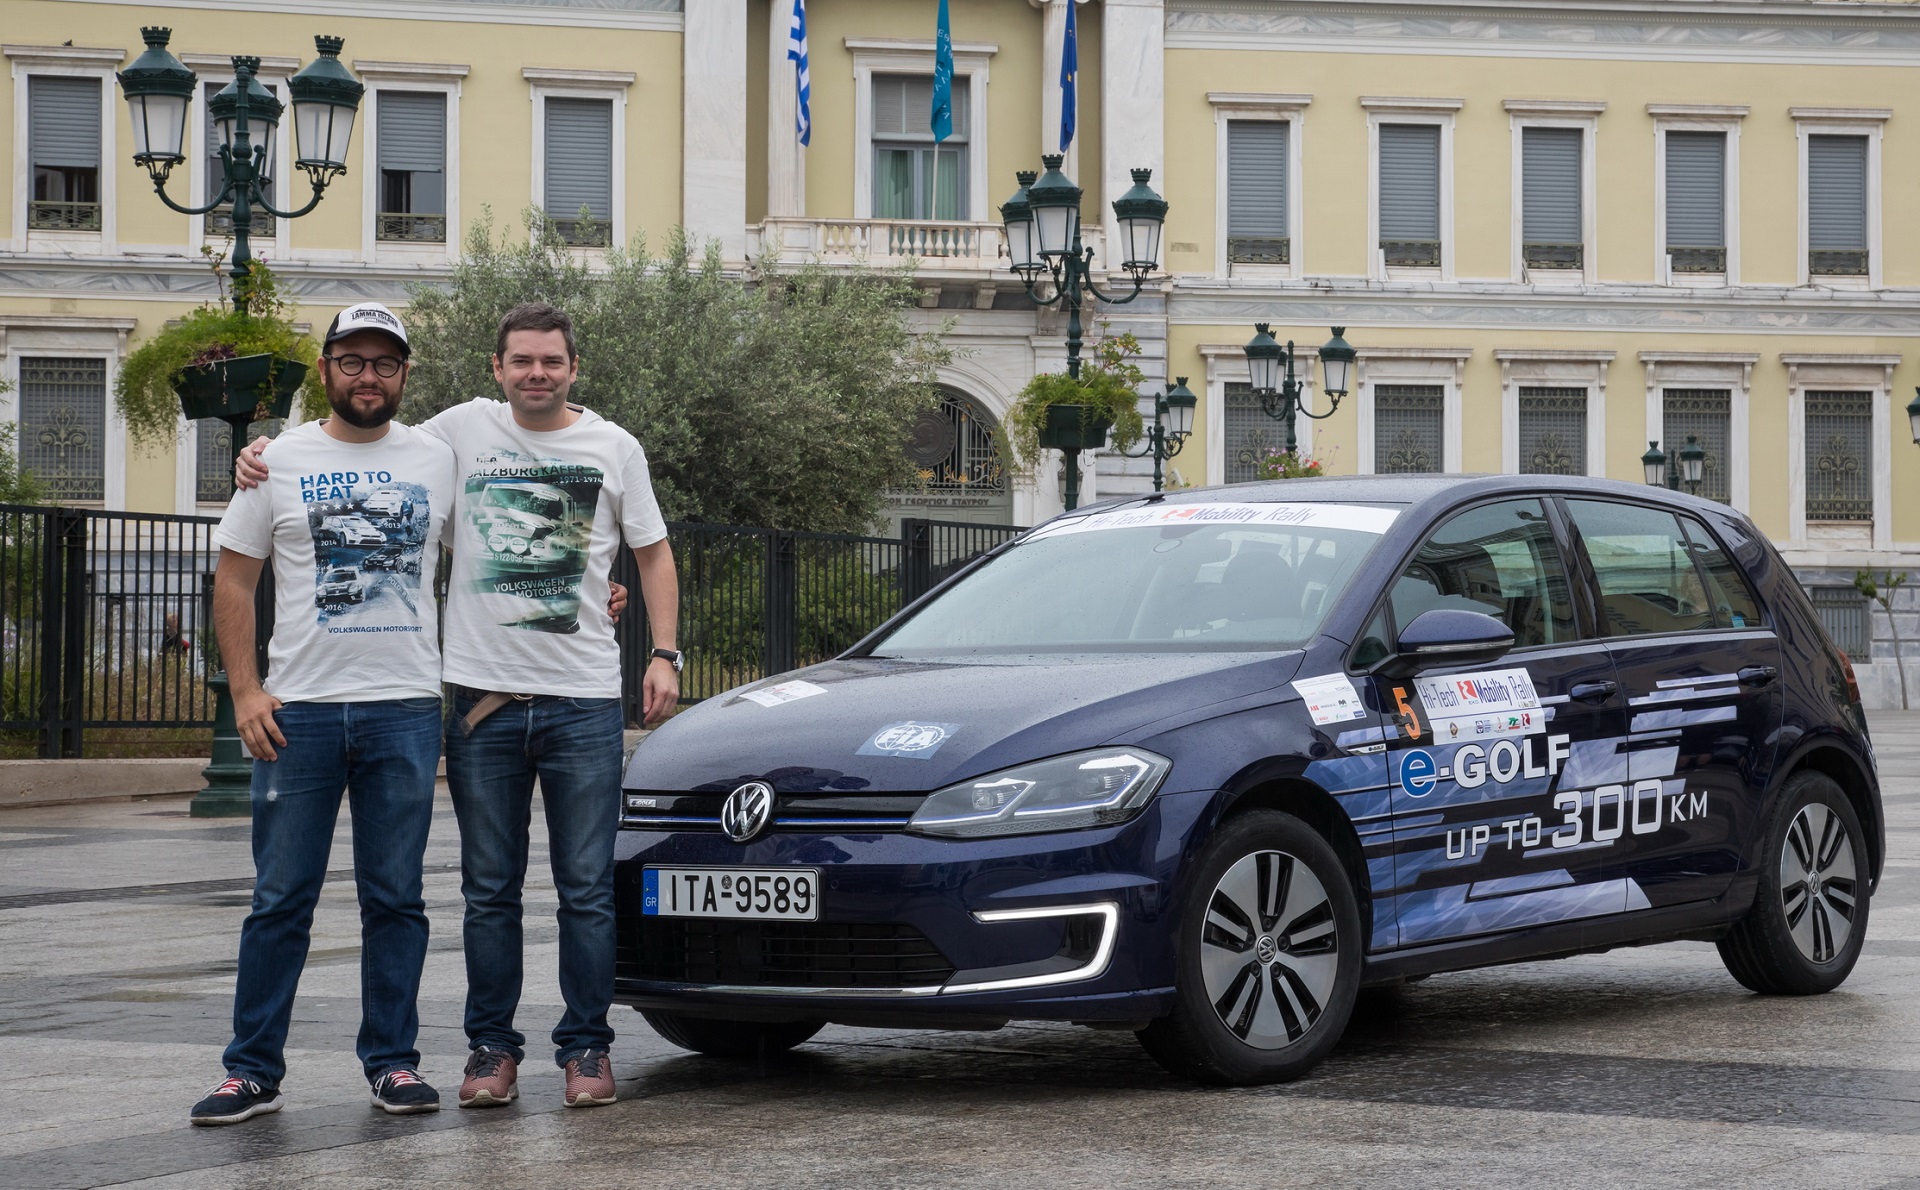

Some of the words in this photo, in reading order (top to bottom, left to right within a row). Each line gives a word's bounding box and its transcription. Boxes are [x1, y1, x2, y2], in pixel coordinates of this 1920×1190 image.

[351, 311, 377, 320] LAMMA
[300, 471, 359, 489] HARD
[363, 471, 392, 483] TO
[302, 485, 354, 503] BEAT
[1190, 507, 1262, 522] Mobility
[1263, 507, 1317, 524] Rally
[493, 577, 565, 592] VOLKSWAGEN
[328, 626, 382, 634] VOLKSWAGEN
[1418, 682, 1460, 709] Hi-Tech
[1472, 678, 1513, 706] Mobility
[1507, 675, 1537, 704] Rally
[1392, 686, 1421, 740] 5
[1400, 734, 1570, 798] e-GOLF
[1446, 824, 1490, 860] UP
[1501, 817, 1542, 850] TO
[1551, 779, 1663, 848] 300
[1670, 790, 1708, 823] KM
[645, 897, 657, 907] GR
